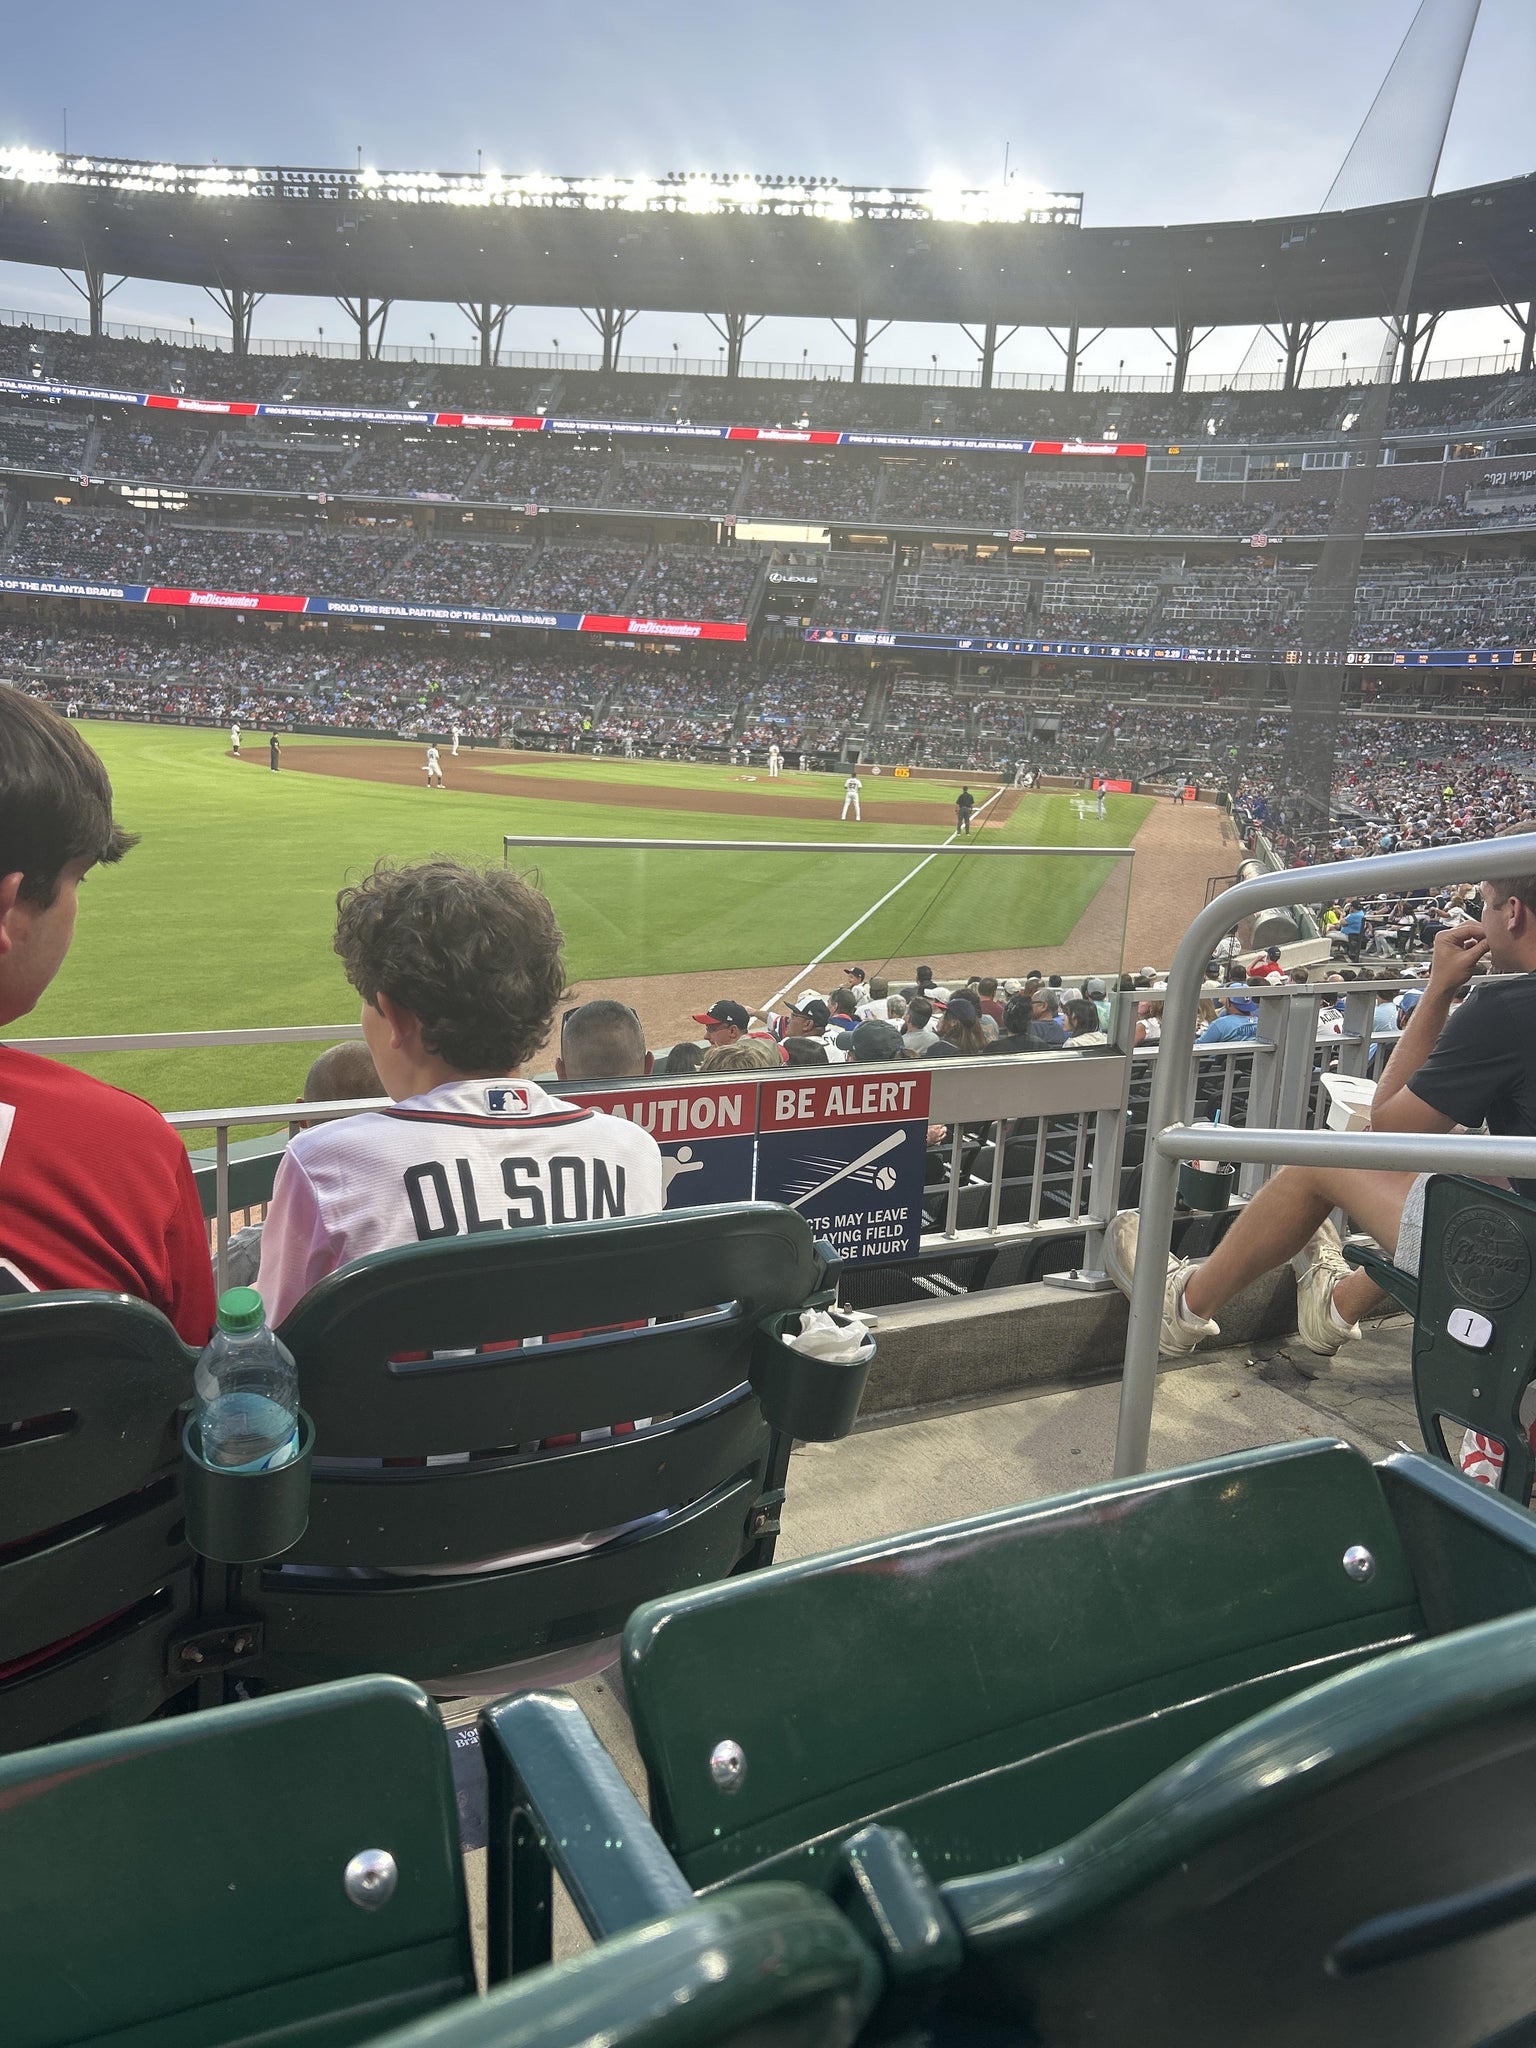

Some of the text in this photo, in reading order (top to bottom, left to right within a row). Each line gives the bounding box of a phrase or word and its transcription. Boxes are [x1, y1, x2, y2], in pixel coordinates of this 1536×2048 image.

[62, 388, 77, 396] THE
[77, 390, 109, 399] ATLANTA
[80, 474, 89, 487] 3
[20, 582, 40, 591] THE
[40, 584, 85, 595] ATLANTA
[86, 587, 124, 597] BRAVES
[189, 592, 259, 608] TireDiscounters
[328, 603, 557, 626] PROUD TIRE RETAIL PARTNER OF THE ATLANTA BRAVES
[628, 620, 702, 636] TireDiscounters
[876, 635, 896, 645] SALE
[1057, 645, 1062, 653] 1
[1363, 654, 1370, 663] 2
[775, 1080, 917, 1121] BE ALERT
[403, 1156, 626, 1241] OLSON
[834, 1212, 864, 1228] MAY
[867, 1207, 908, 1224] LEAVE
[866, 1224, 903, 1240] FIELD
[862, 1239, 910, 1257] INJURY
